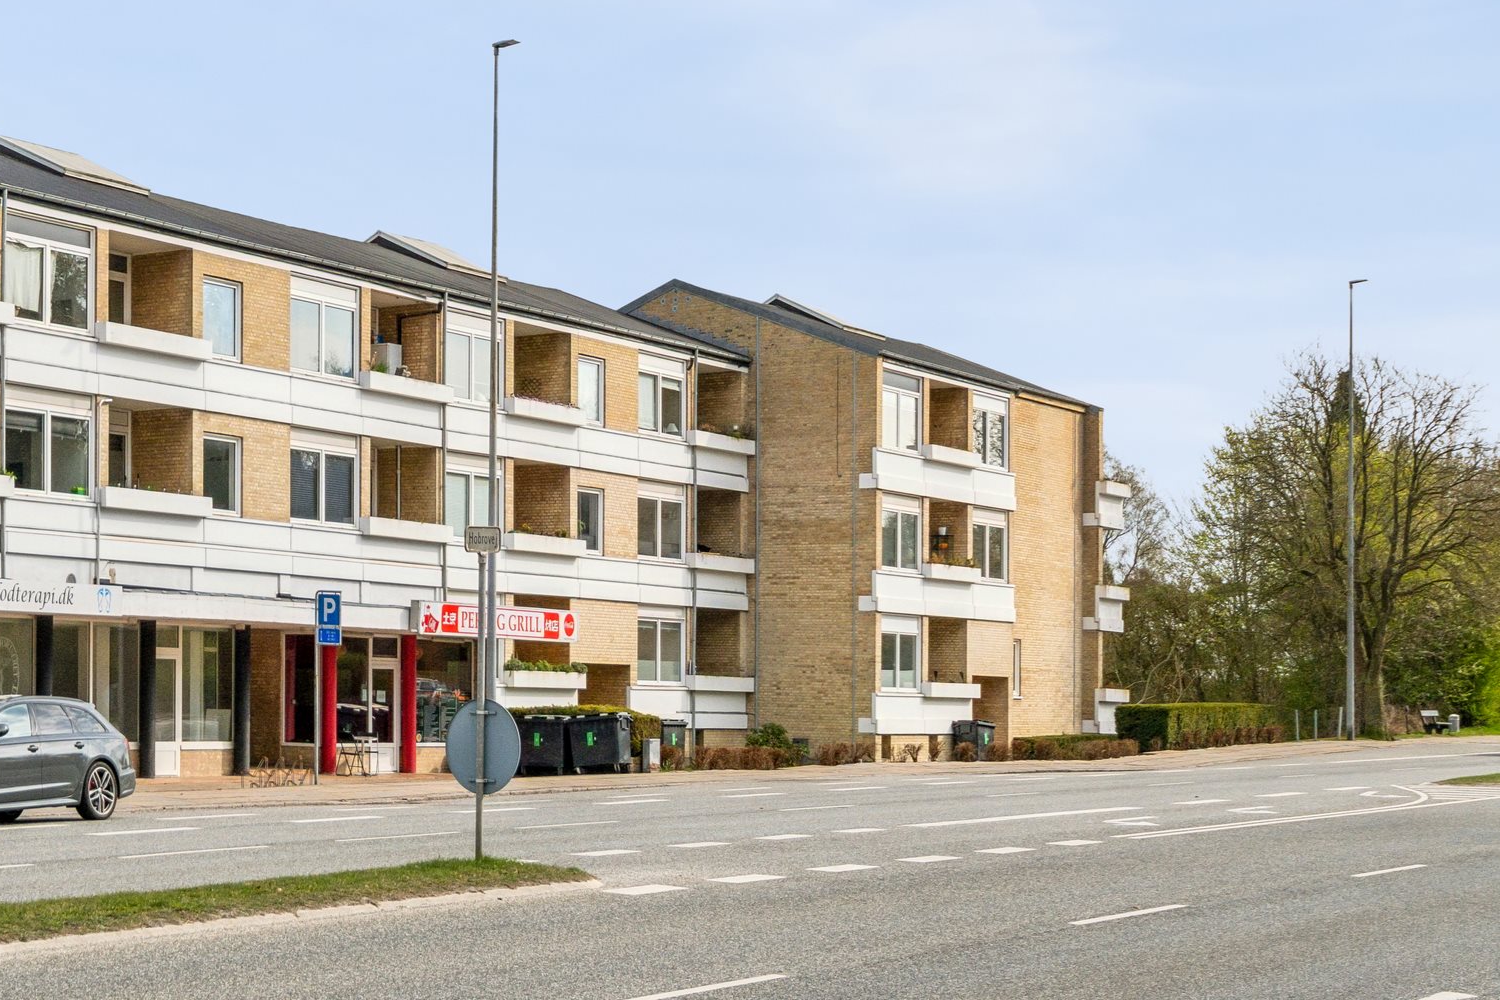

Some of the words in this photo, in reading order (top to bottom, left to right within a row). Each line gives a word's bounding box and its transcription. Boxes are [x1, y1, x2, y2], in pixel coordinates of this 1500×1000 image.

[468, 531, 498, 549] Hobrovej
[323, 597, 336, 622] P
[508, 613, 542, 634] GRILL
